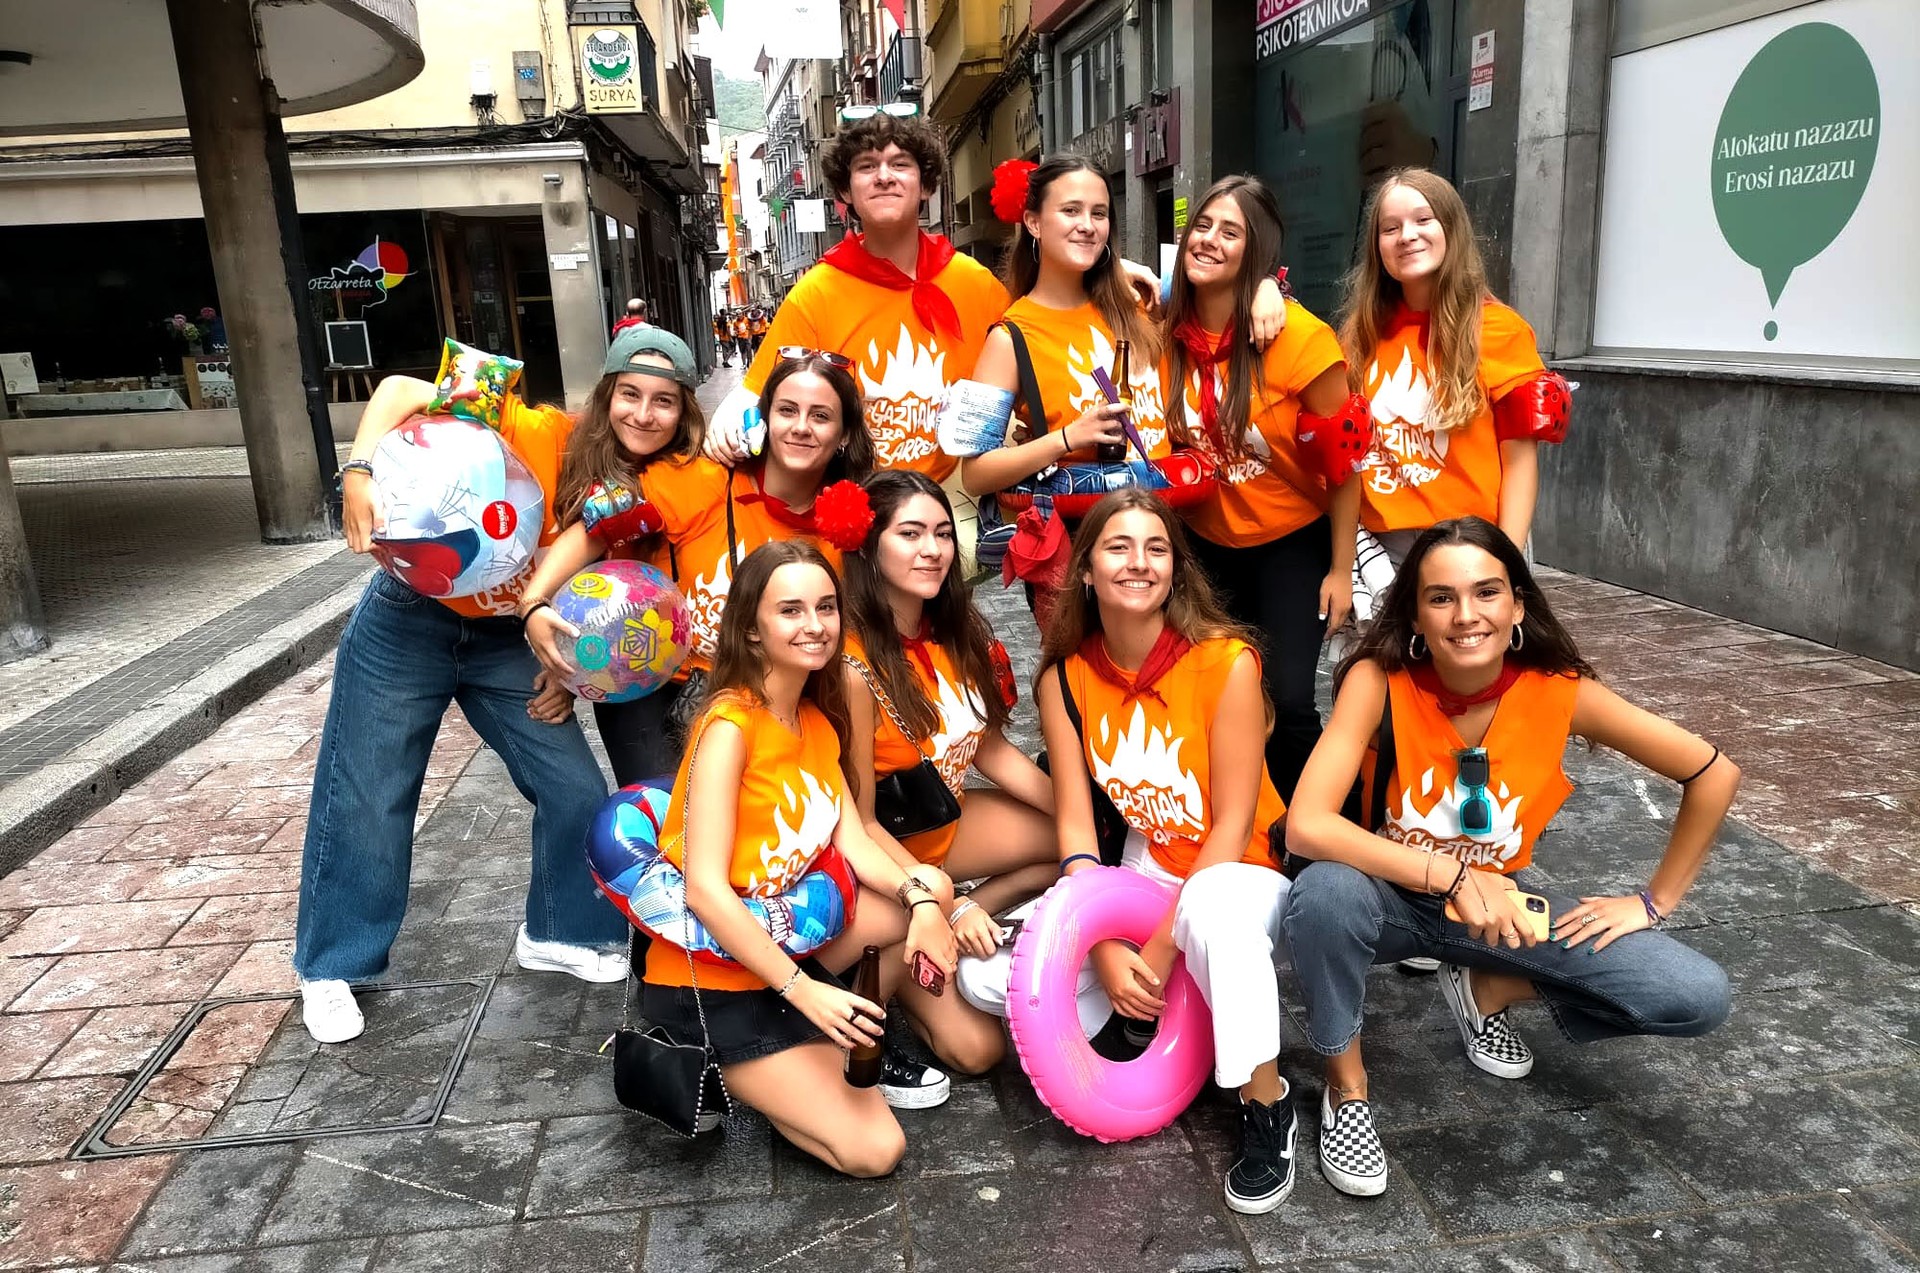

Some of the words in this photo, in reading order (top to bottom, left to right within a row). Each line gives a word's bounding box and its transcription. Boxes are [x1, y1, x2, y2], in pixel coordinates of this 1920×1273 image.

[589, 89, 636, 101] SURYA
[1717, 130, 1789, 160] Alokatu
[1794, 117, 1874, 148] nazazu
[1725, 165, 1774, 193] Erosi
[1778, 160, 1855, 187] nazazu
[308, 277, 373, 290] Otzarreta
[1107, 782, 1206, 832] GAZTIAK
